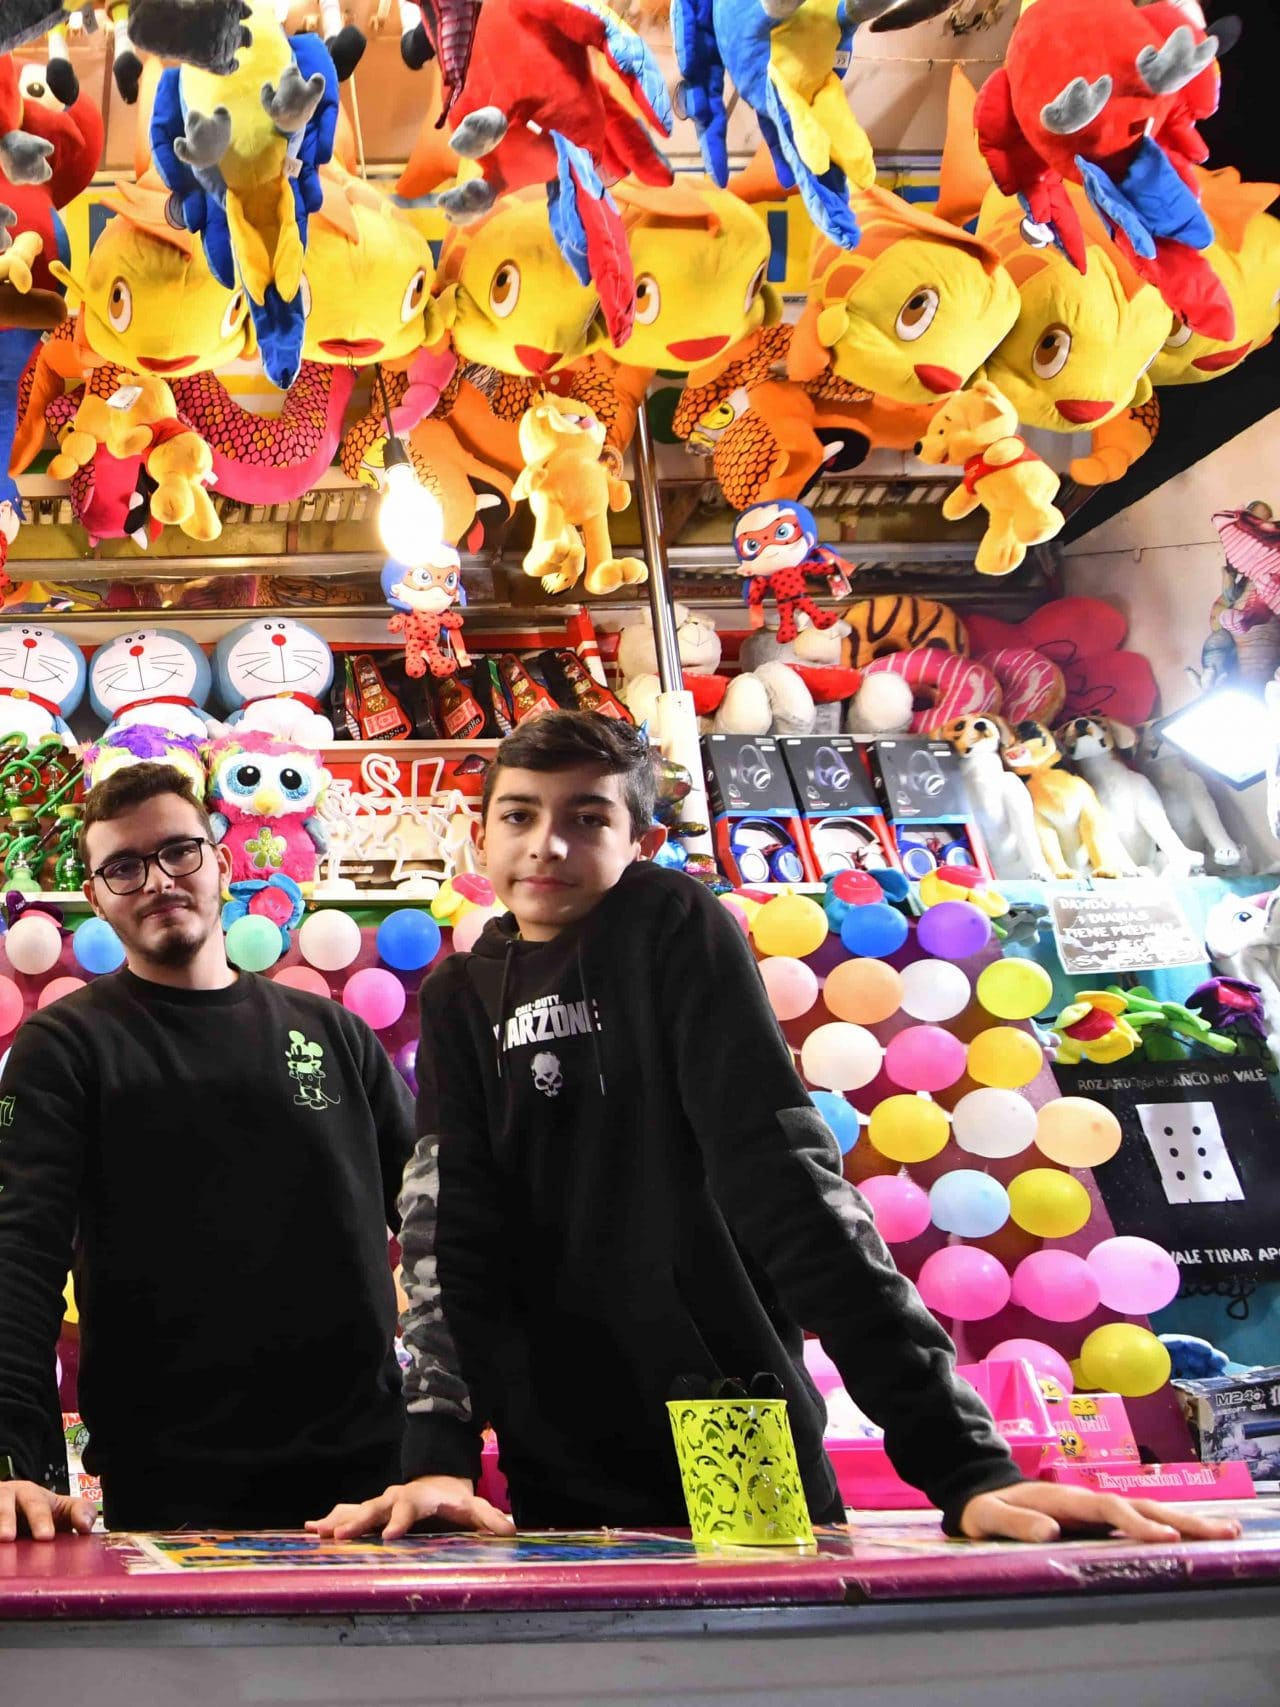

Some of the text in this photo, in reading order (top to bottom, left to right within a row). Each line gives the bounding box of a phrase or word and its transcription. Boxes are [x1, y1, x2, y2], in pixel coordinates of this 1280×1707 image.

[1233, 1068, 1267, 1083] VALE
[1203, 1247, 1254, 1264] TIRAR
[1096, 1468, 1217, 1491] Expression ball
